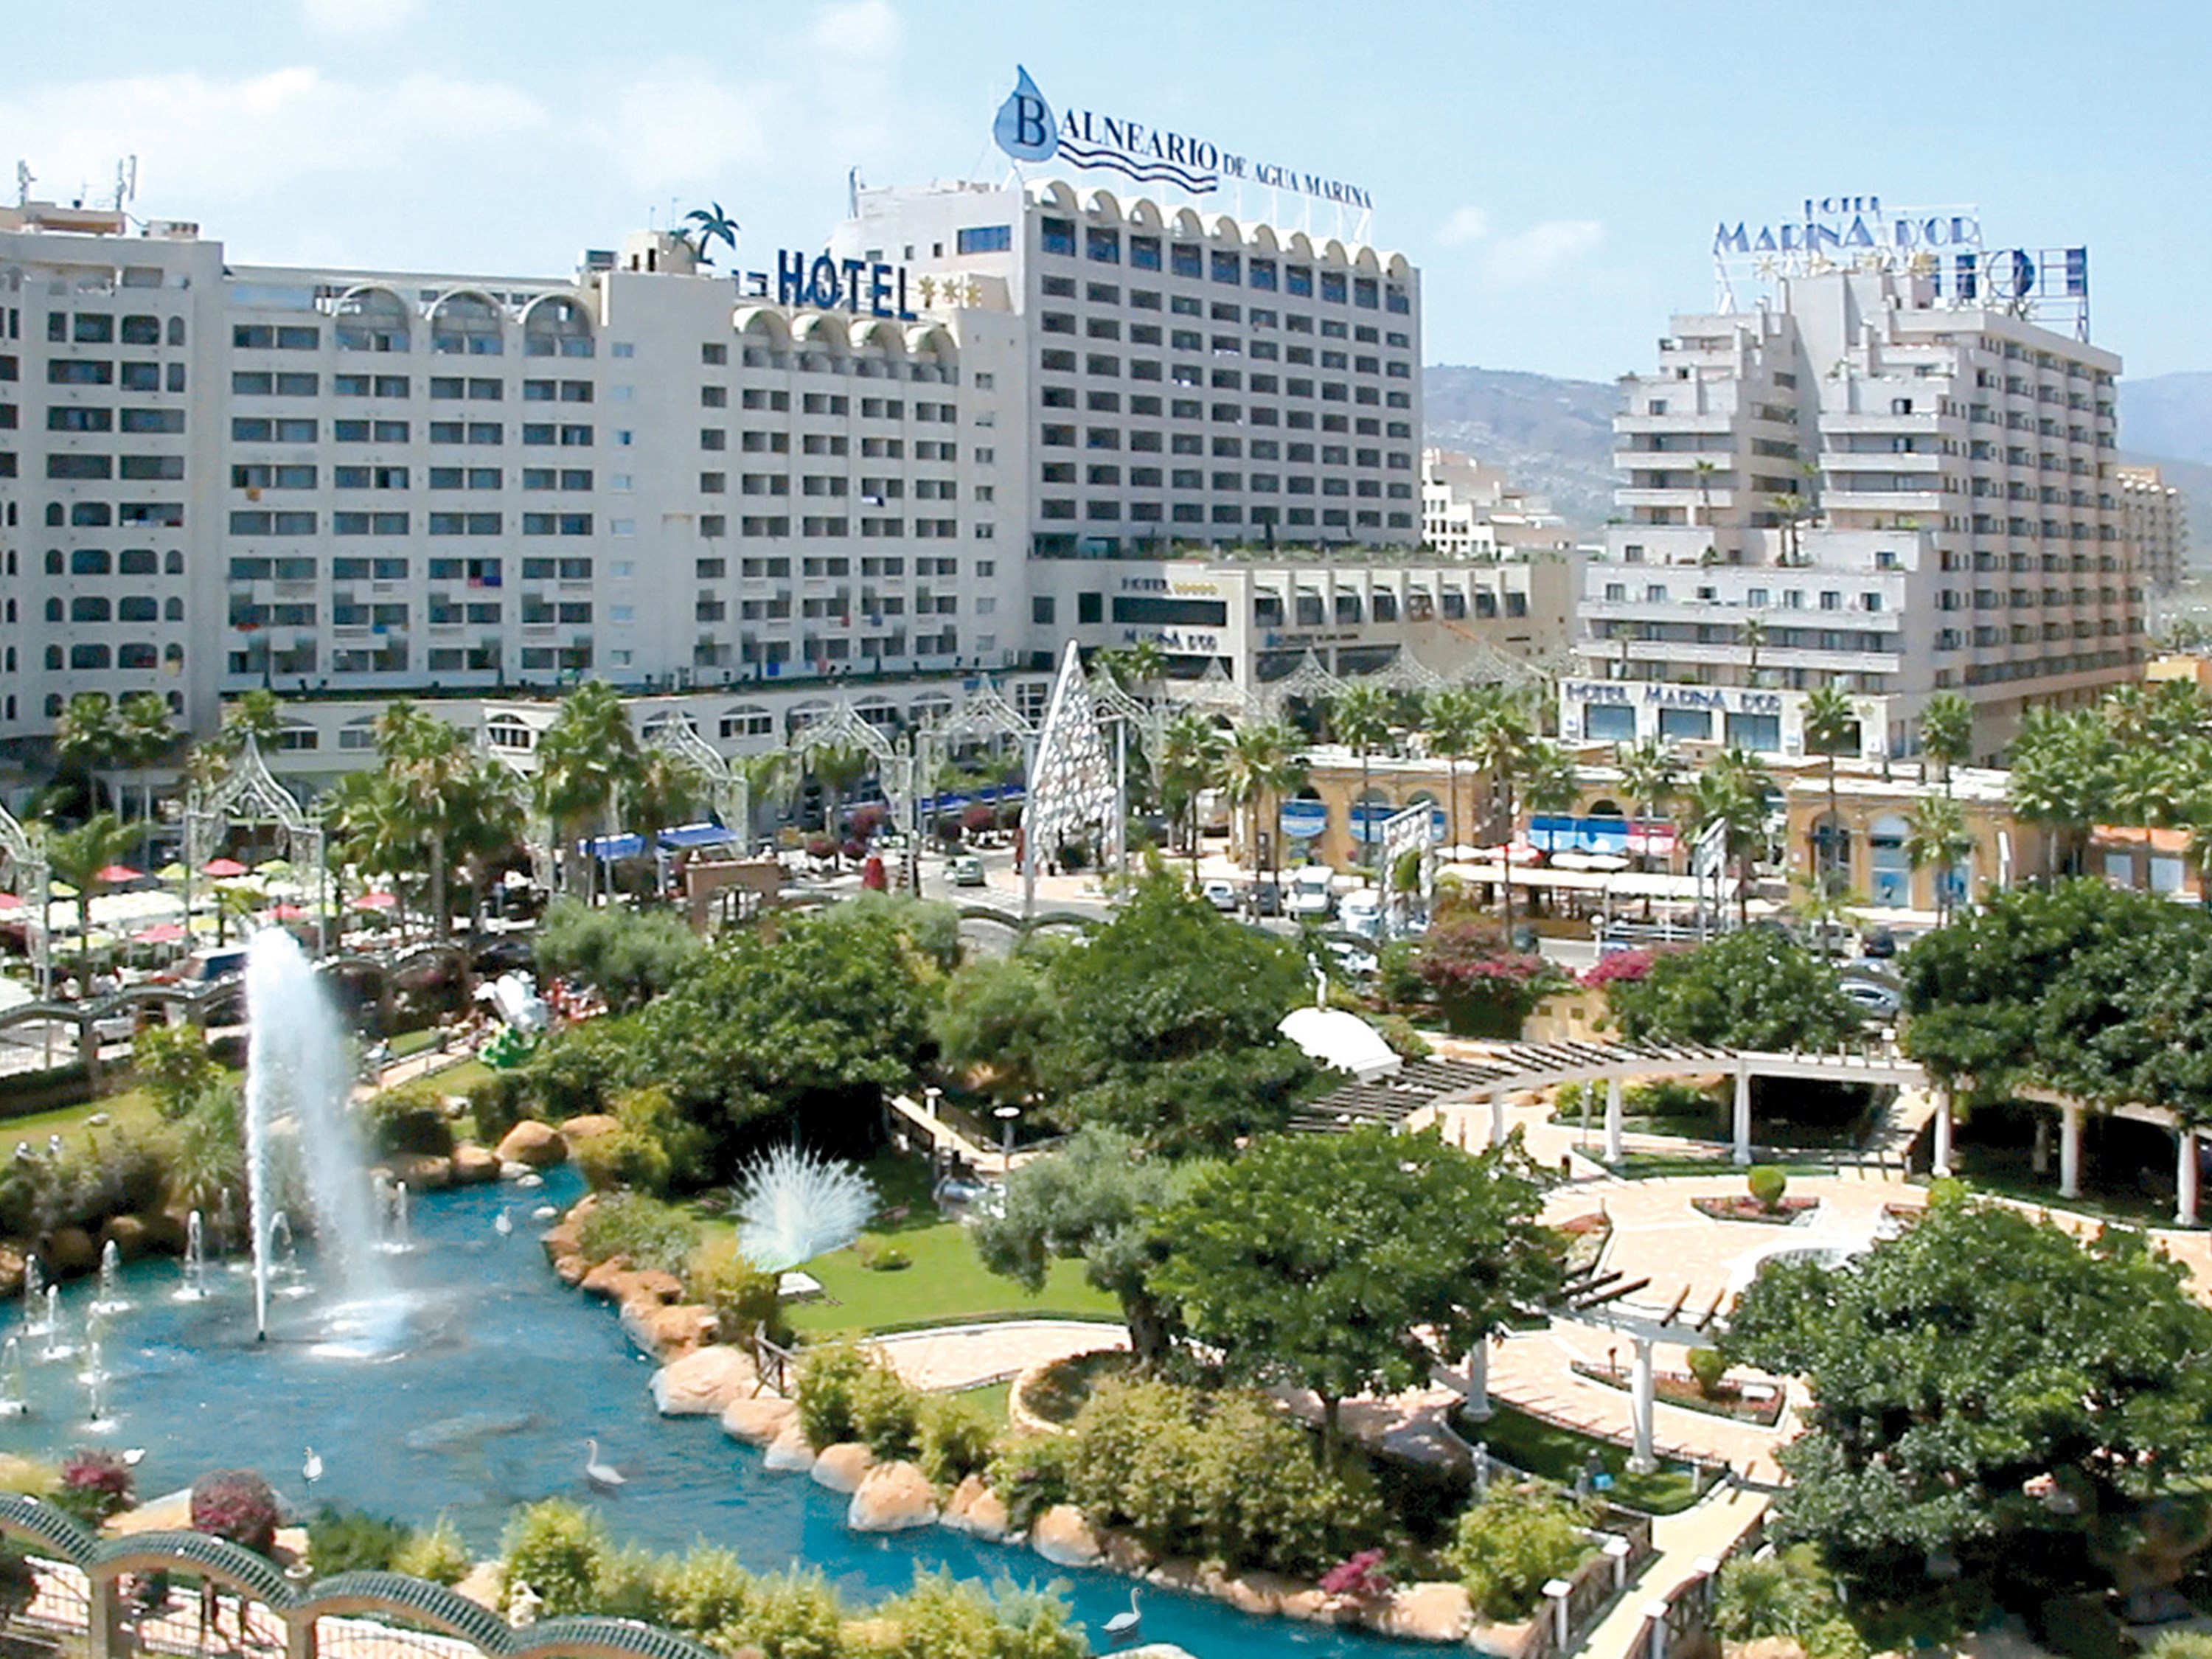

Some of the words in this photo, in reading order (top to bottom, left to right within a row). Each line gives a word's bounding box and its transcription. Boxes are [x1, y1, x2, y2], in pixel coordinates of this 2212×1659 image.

[1012, 94, 1218, 171] BALNEARIO
[1223, 153, 1248, 179] DE
[1254, 162, 1299, 192] AGUA
[1304, 173, 1373, 209] MARINA
[1804, 195, 1879, 215] HOTEL
[1713, 215, 1875, 255] MARINA
[778, 248, 918, 322] HOTEL
[1566, 683, 1629, 703] HOTEL
